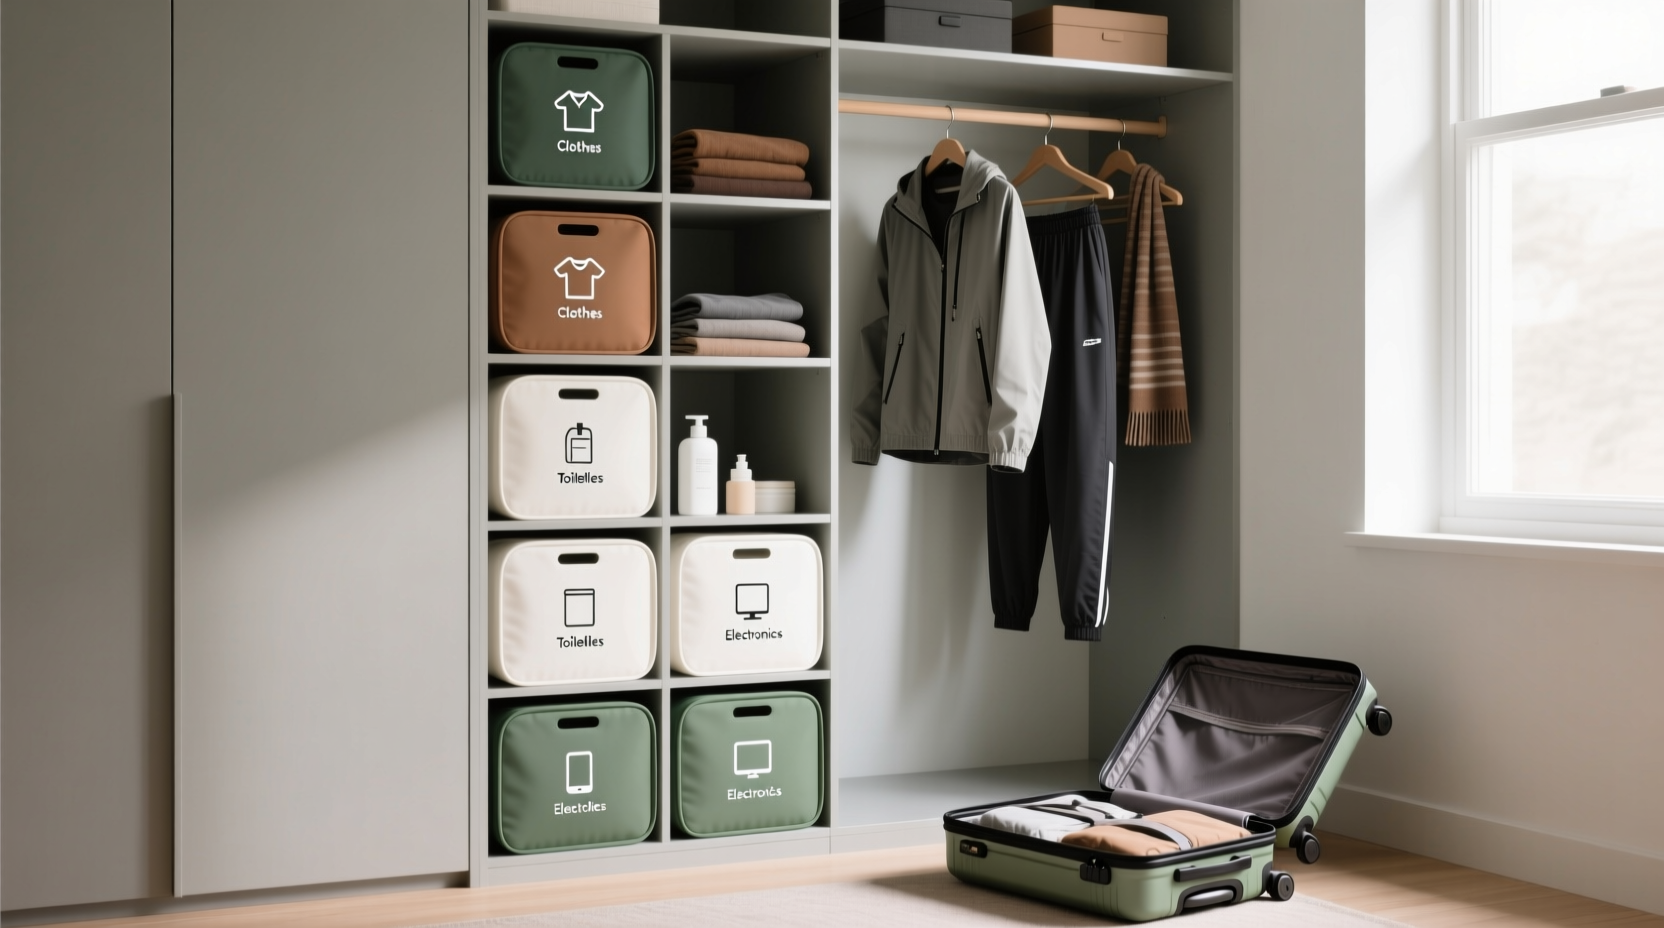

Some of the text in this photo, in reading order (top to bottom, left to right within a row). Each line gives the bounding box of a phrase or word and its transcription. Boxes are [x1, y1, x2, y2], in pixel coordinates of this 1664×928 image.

[557, 139, 602, 153] Clothes
[557, 305, 603, 319] Clothes
[725, 627, 783, 641] Electronics
